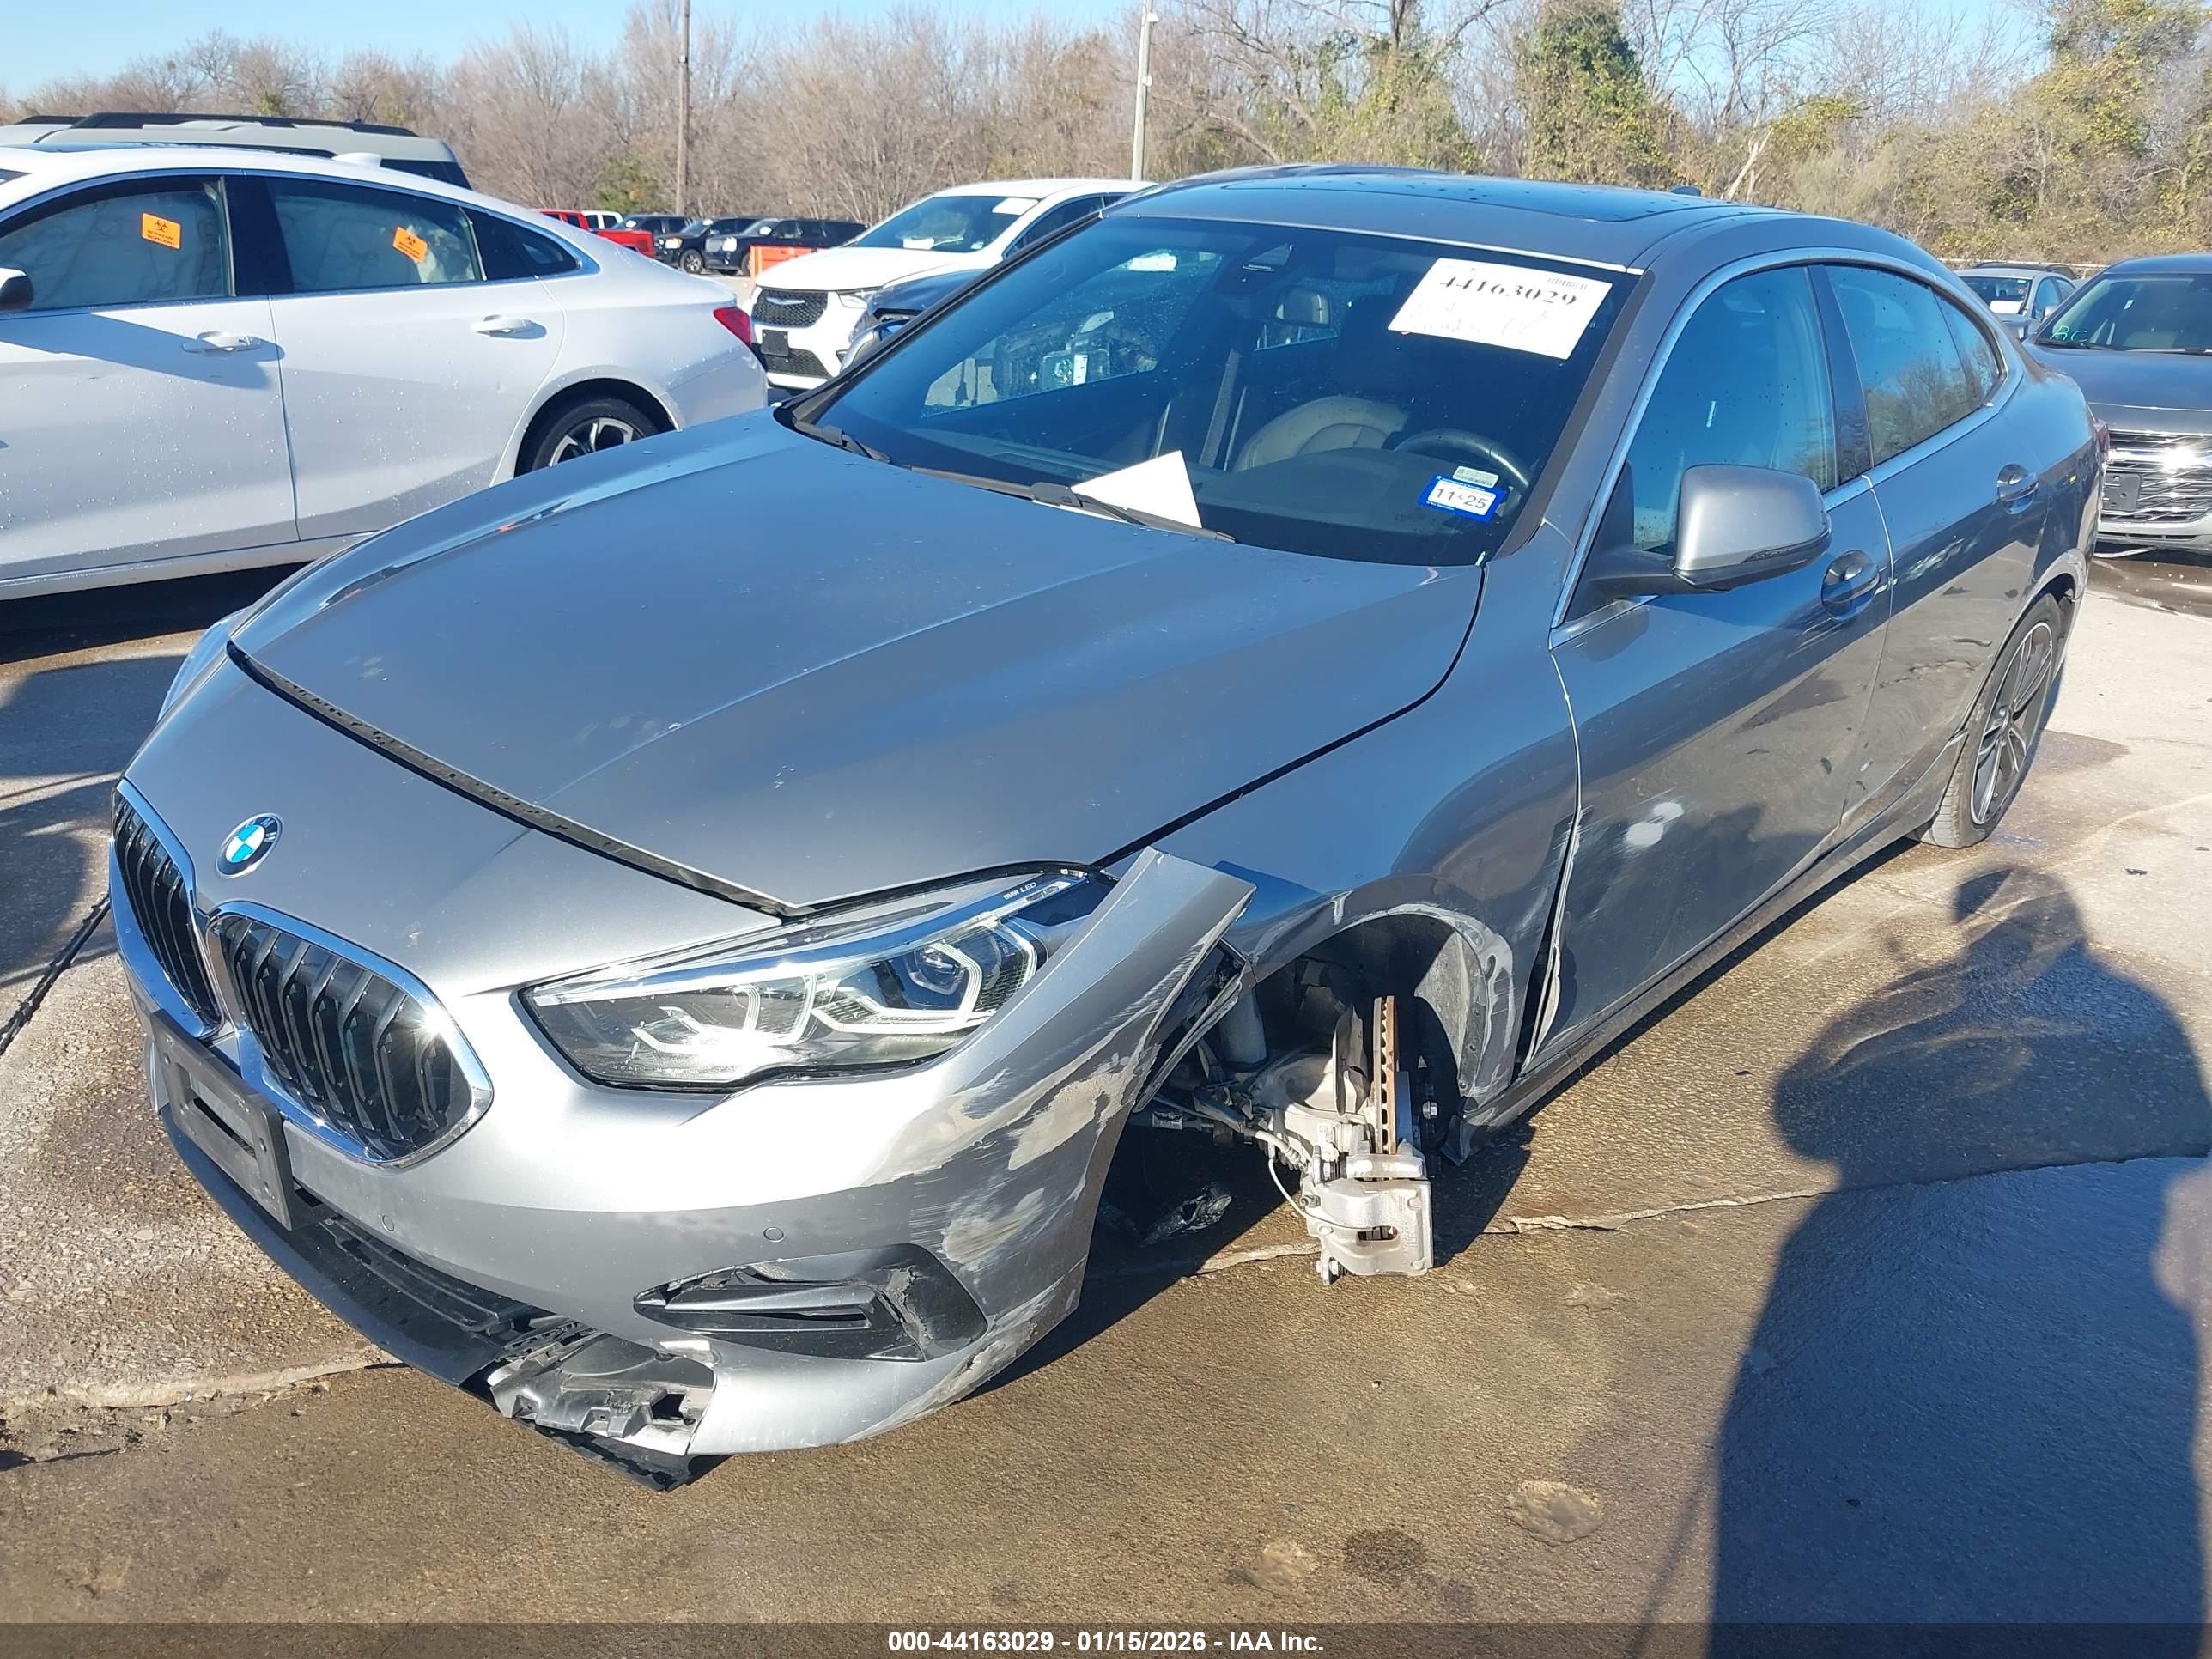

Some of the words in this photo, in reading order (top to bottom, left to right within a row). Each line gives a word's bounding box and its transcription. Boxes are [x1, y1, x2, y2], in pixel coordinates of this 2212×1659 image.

[1439, 275, 1577, 307] 44163029
[1437, 488, 1455, 501] 11
[1463, 495, 1489, 509] 25
[1019, 881, 1037, 893] LED
